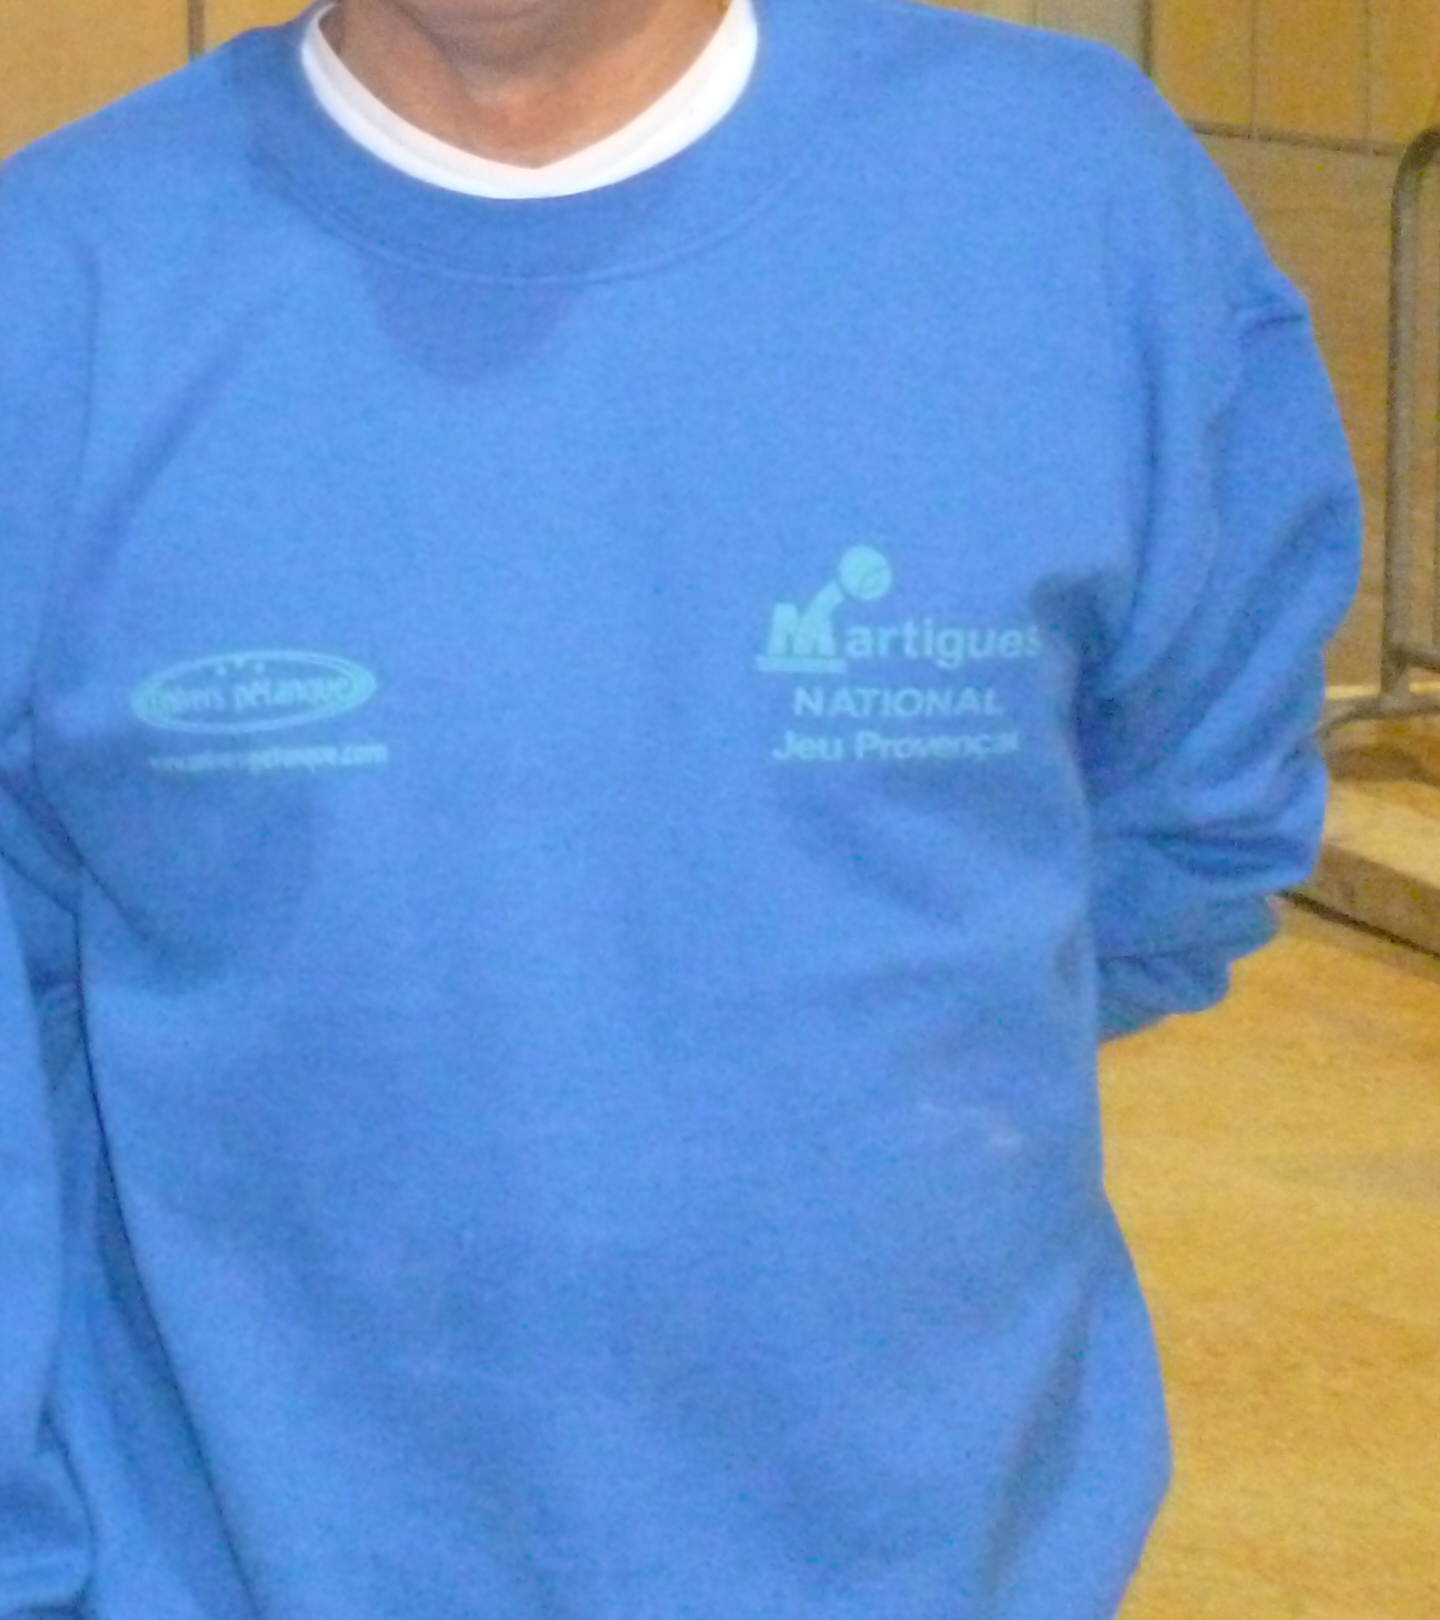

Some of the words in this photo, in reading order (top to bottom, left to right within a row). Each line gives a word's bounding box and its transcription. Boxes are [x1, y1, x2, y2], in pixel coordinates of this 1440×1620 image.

[767, 580, 1042, 670] Martigues
[792, 684, 1006, 719] NATIONAL
[770, 729, 845, 761] Jeu
